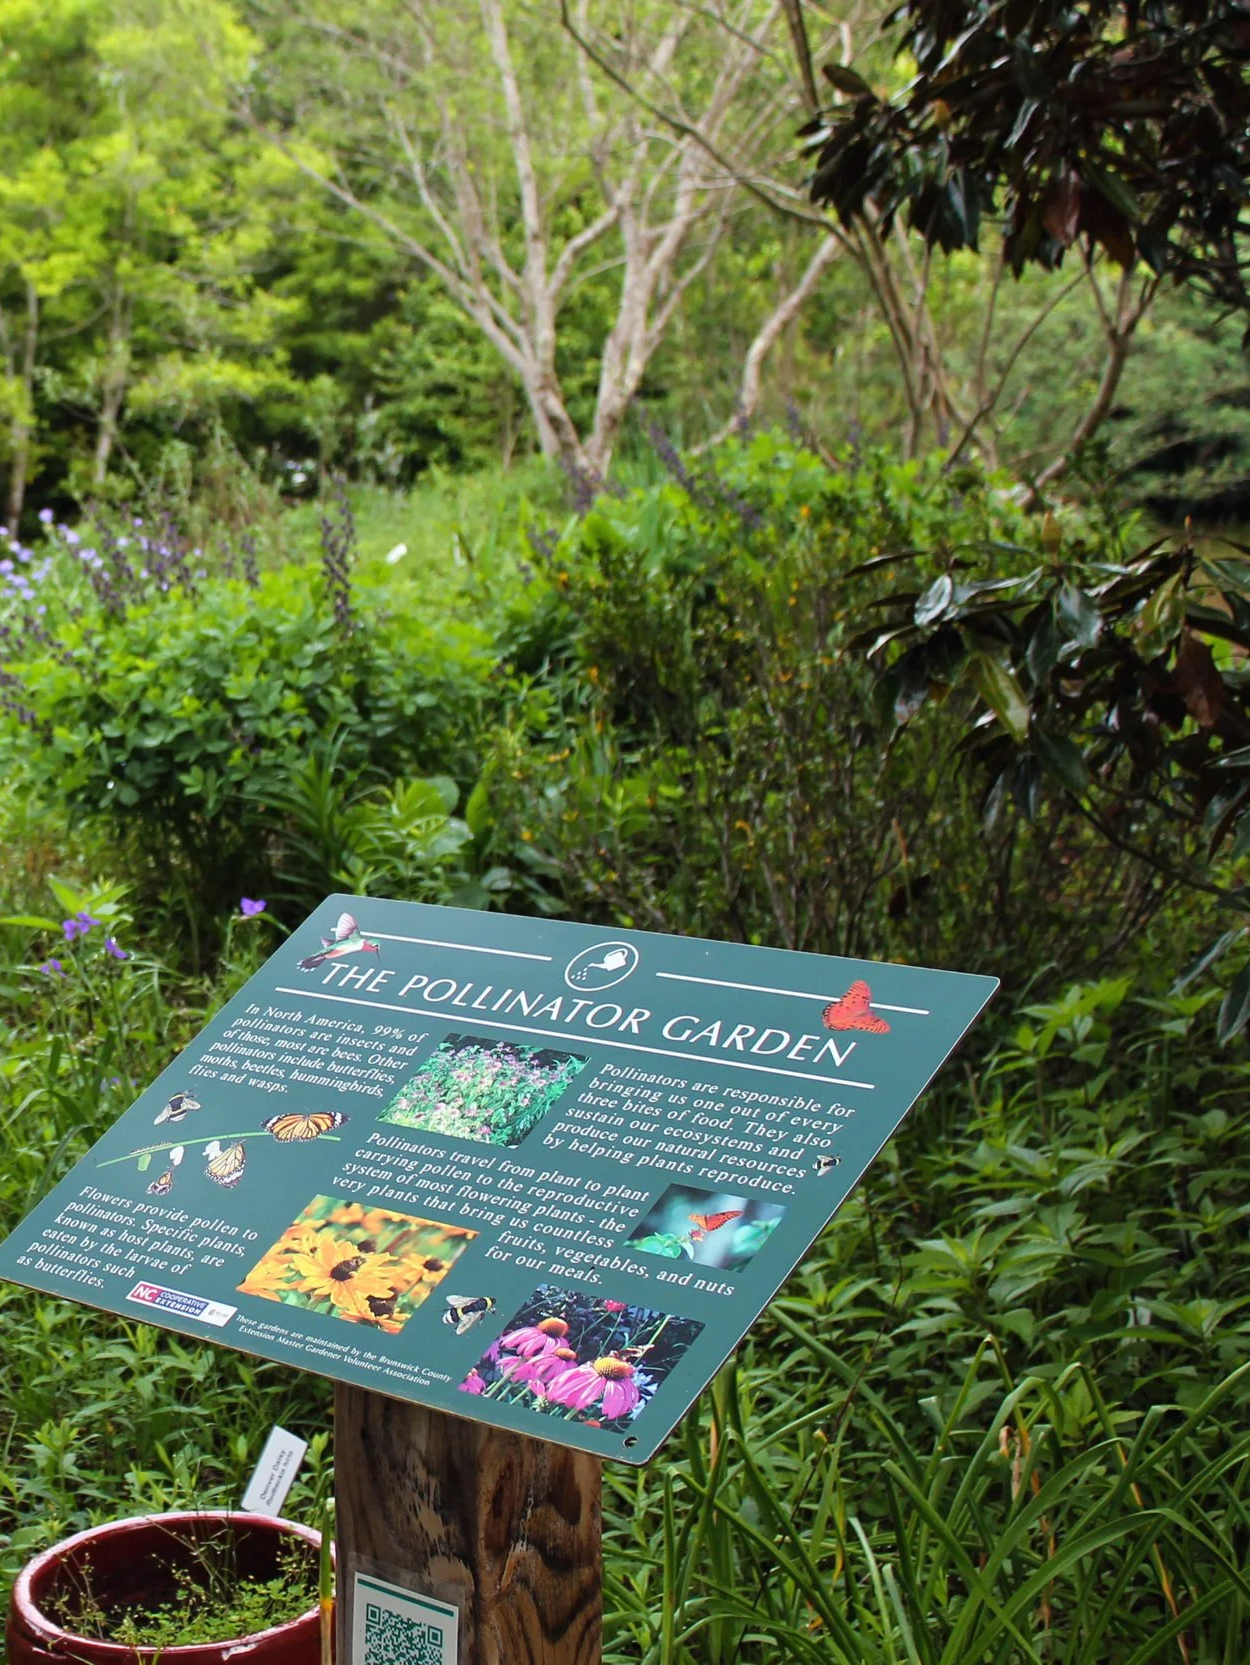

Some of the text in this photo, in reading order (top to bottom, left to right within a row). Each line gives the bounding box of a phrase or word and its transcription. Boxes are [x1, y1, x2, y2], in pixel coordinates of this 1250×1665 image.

[230, 1017, 418, 1056] pollinators are insects and
[244, 1002, 429, 1043] In North America, 99% of
[321, 961, 857, 1066] THE POLLINATOR GARDEN
[198, 1054, 383, 1097] moths, beetles, hummingbirds,
[207, 1041, 395, 1084] pollinators include butterflies,
[222, 1028, 408, 1069] of those, most are bees. Other
[188, 1063, 288, 1093] flies and wasps.
[599, 1063, 855, 1117] Pollinators are responsible for
[577, 1091, 831, 1148] three bites of food. They also
[588, 1076, 843, 1135] bringing us one out of every
[550, 1121, 806, 1178] produce our natural resources
[564, 1107, 805, 1160] sustain our ecosystems and
[354, 1148, 639, 1217] carrying pollen to the reproductive
[365, 1131, 649, 1201] Pollinators travel from plant to plant
[542, 1132, 795, 1194] by helping plants reproduce.
[78, 1185, 258, 1240] Flowers provide pollen to
[332, 1175, 614, 1248] very plants that bring us countless
[341, 1162, 393, 1180] system
[395, 1173, 418, 1184] of
[414, 1178, 453, 1194] most
[455, 1184, 533, 1214] flowering
[531, 1203, 585, 1223] plants
[598, 1216, 626, 1232] the
[41, 1228, 192, 1275] eaten by the larvae of
[53, 1211, 225, 1267] known as host plants, are
[63, 1201, 245, 1257] pollinators. Specific plants,
[16, 1255, 104, 1288] as butterflies.
[25, 1241, 135, 1278] pollinators such
[484, 1245, 602, 1284] for our meals.
[496, 1230, 734, 1295] fruits, vegetables, and nuts
[134, 1285, 158, 1301] NC
[154, 1298, 202, 1315] EXTENSION
[160, 1291, 208, 1309] COOPERATIVE
[235, 1314, 257, 1326] These
[256, 1322, 289, 1335] gardens
[289, 1331, 303, 1339] are
[304, 1335, 350, 1352] maintained
[350, 1346, 361, 1357] by
[362, 1351, 377, 1360] the
[378, 1355, 419, 1373] Brunswick
[420, 1367, 452, 1382] County
[238, 1324, 430, 1386] Extension Master Gardener Volunteer Association
